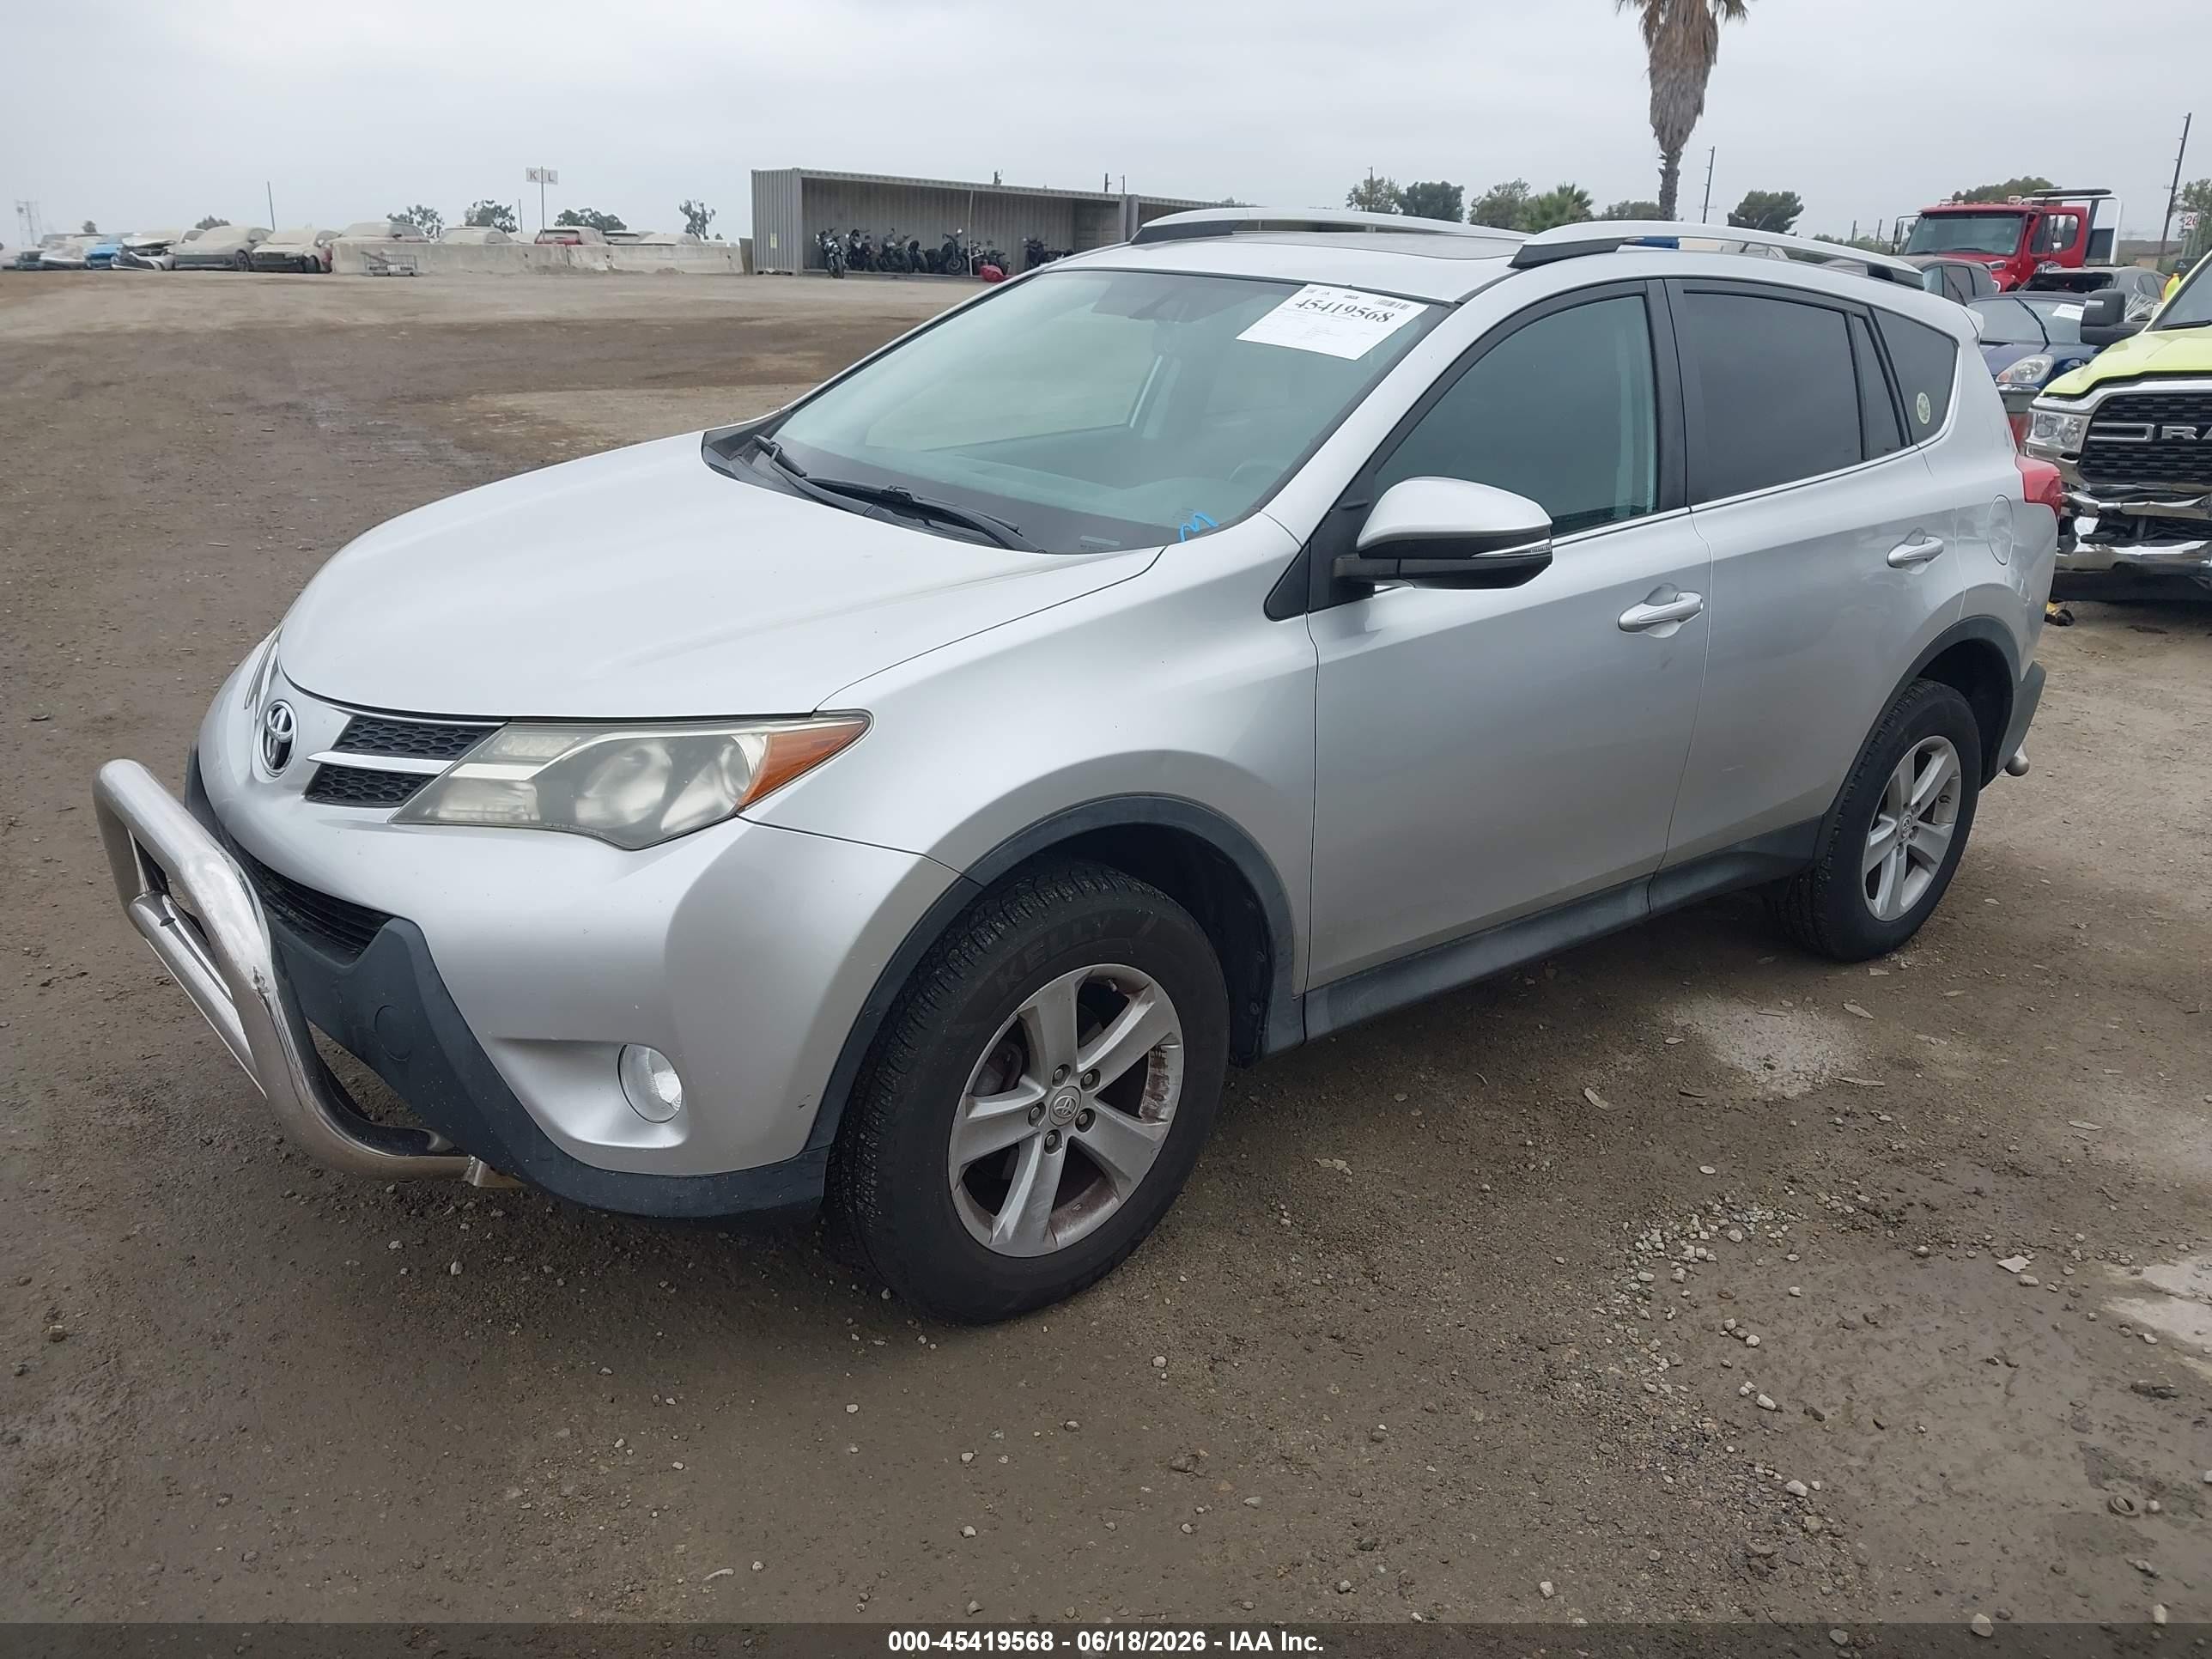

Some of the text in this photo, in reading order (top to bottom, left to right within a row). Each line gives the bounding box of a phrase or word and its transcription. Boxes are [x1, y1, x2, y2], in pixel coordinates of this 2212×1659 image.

[529, 170, 555, 182] K L
[1294, 298, 1395, 323] 45419568
